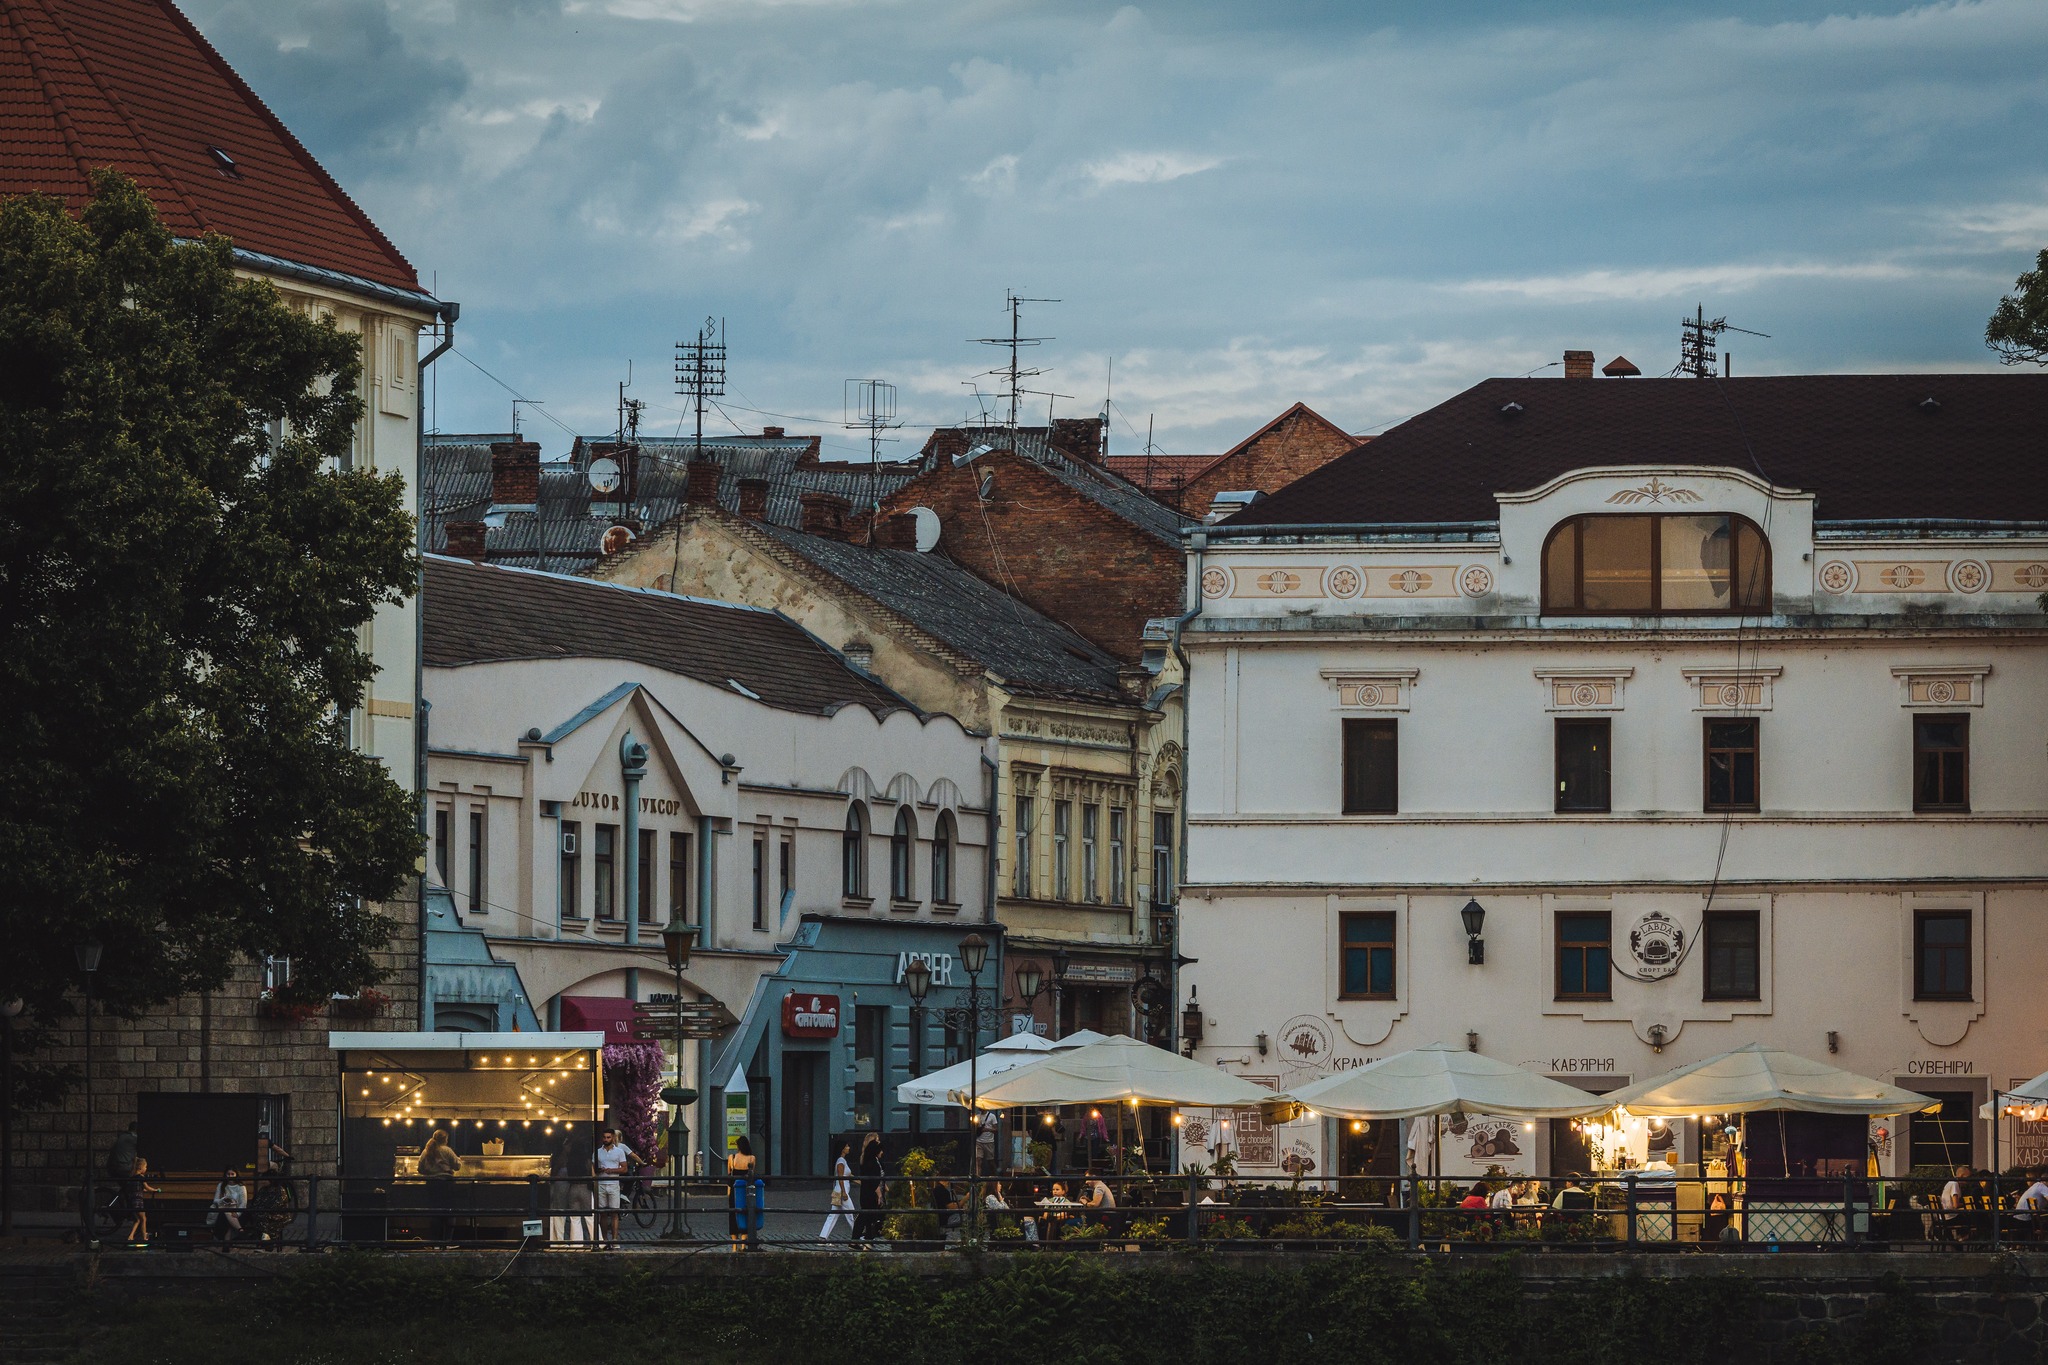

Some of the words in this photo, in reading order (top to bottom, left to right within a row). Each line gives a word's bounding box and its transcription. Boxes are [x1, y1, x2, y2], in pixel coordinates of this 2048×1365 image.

[1640, 923, 1673, 935] LABDA
[1551, 1058, 1615, 1072] КАВ'ЯРНЯ
[1908, 1060, 1973, 1075] СУВЕНІРИ
